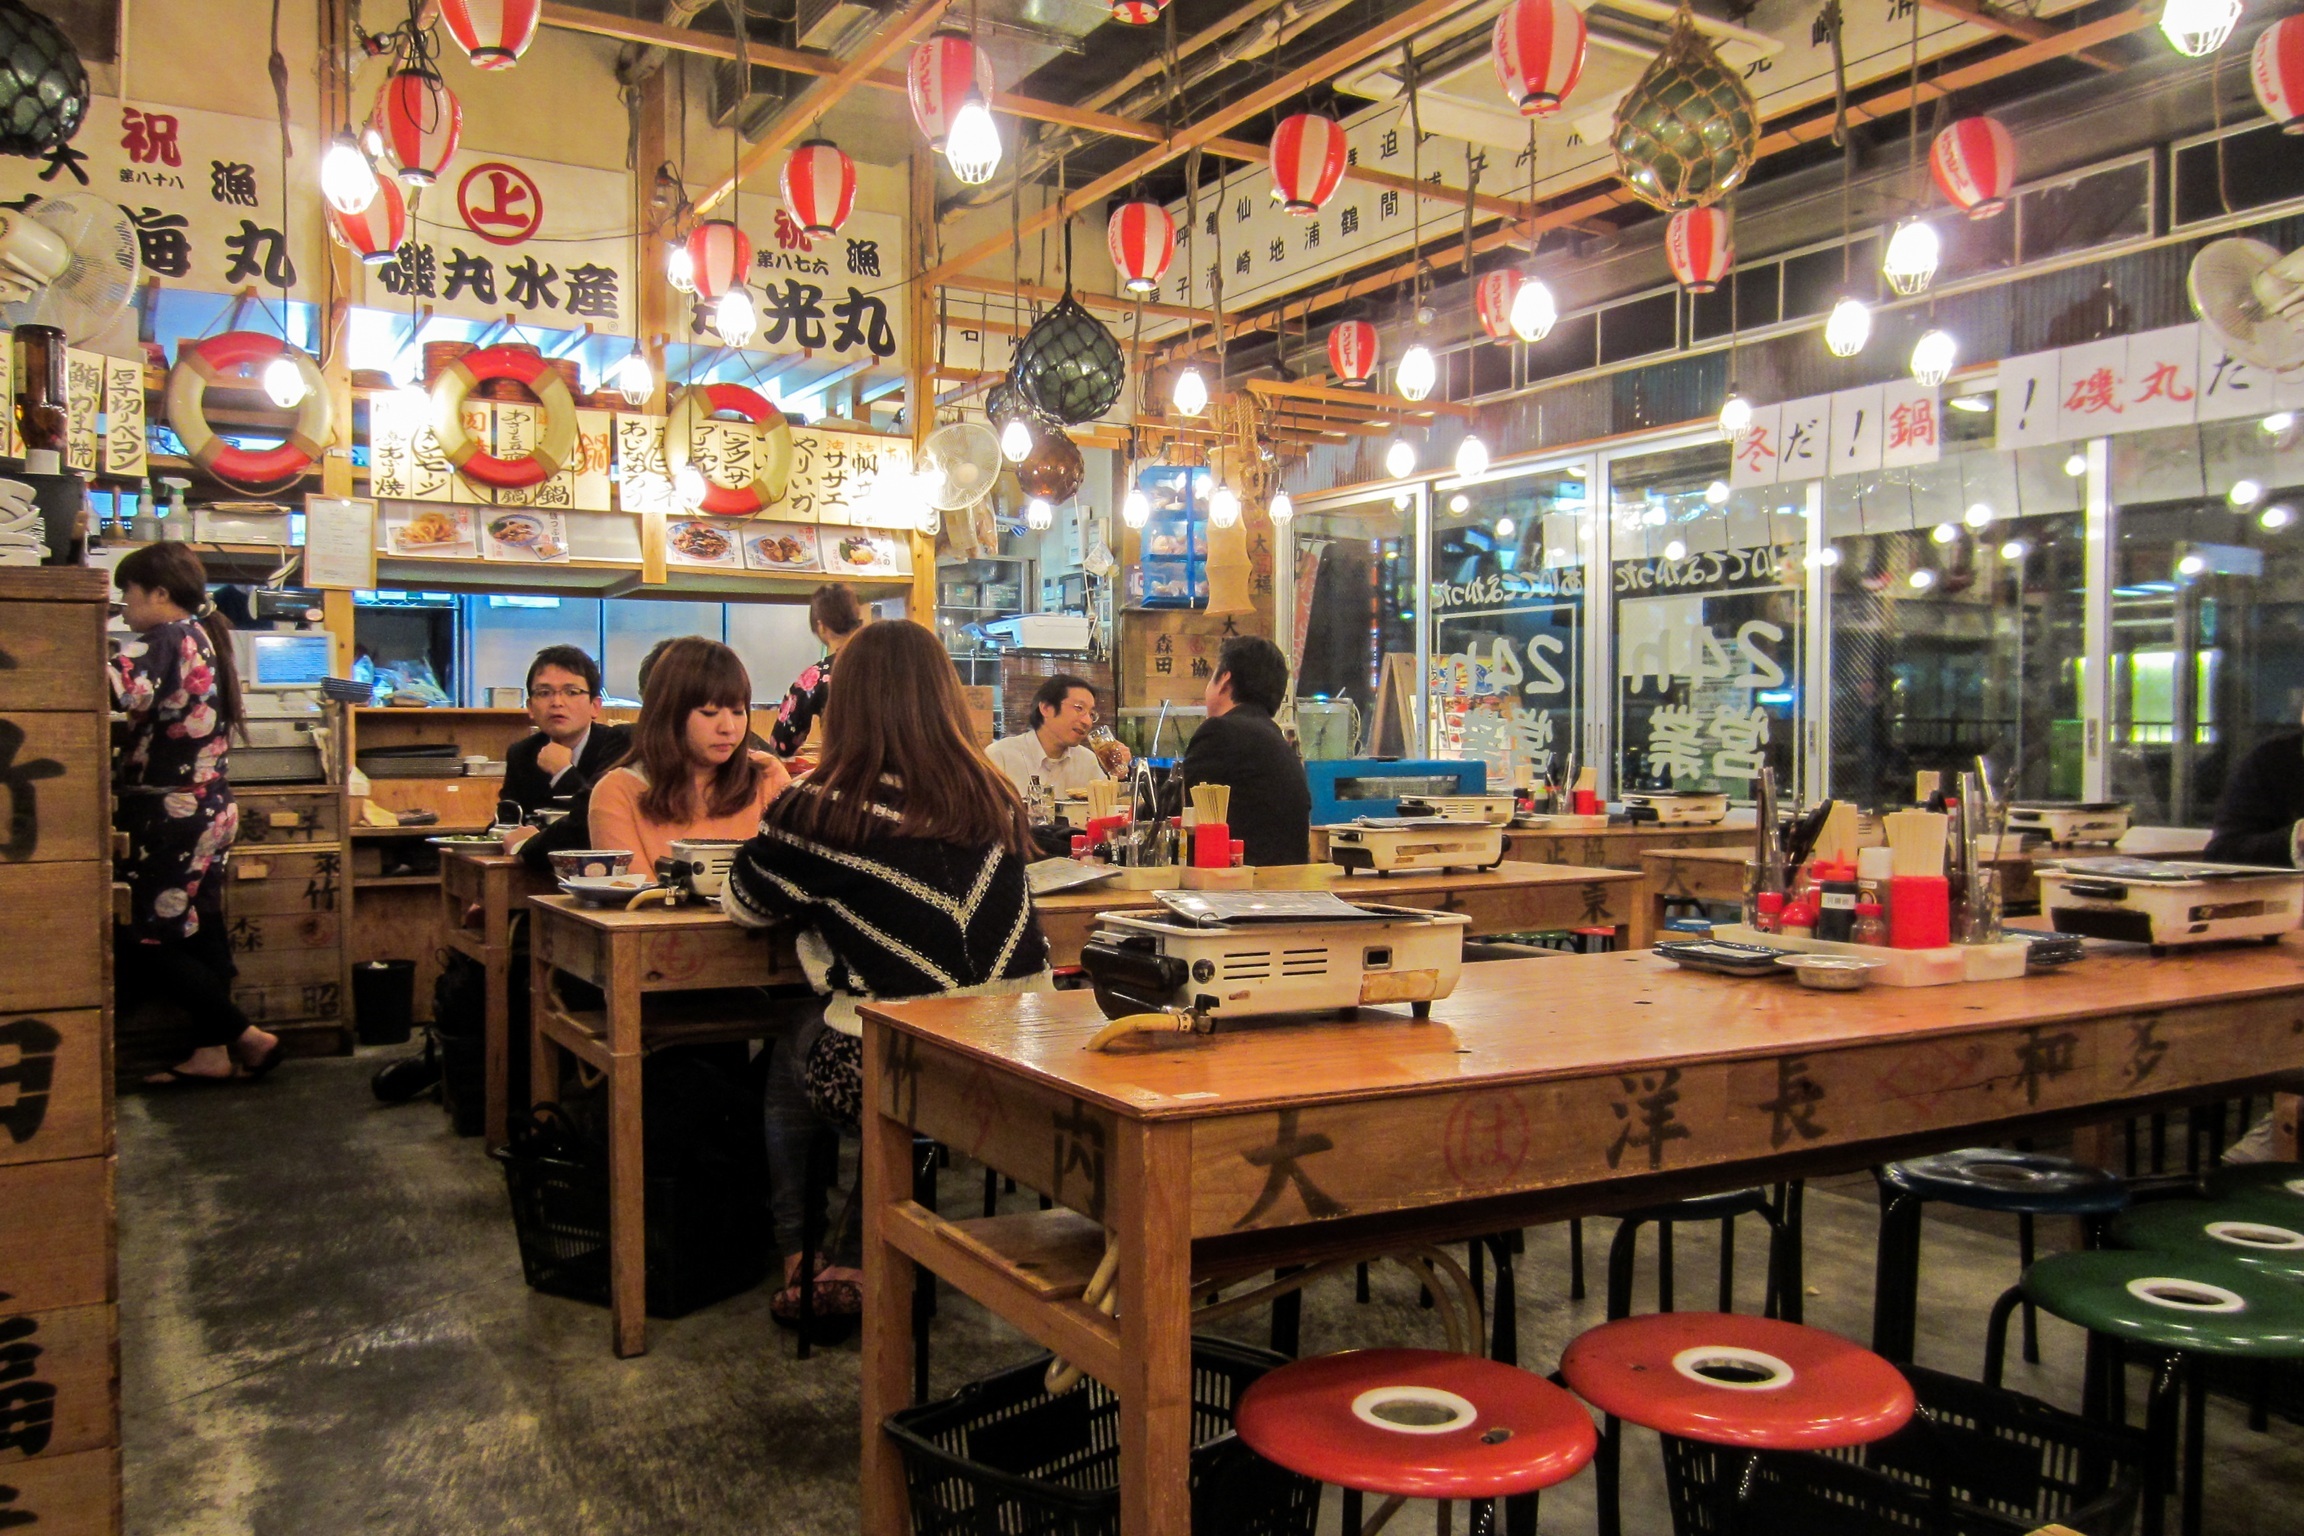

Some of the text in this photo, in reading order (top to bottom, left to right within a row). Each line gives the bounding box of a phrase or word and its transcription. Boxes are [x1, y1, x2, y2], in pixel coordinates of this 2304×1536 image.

[120, 106, 182, 168] 祝
[119, 168, 185, 190] 第八十八
[210, 159, 259, 208] 漁
[470, 170, 532, 228] 上
[756, 249, 830, 276] 第八七六
[846, 238, 881, 278] 漁
[1236, 195, 1252, 276] 仙崎
[377, 240, 620, 320] 磯丸水産
[619, 420, 648, 508] あじなめろう
[790, 435, 819, 514] やりいか
[1233, 1108, 1350, 1229] 大
[1606, 1069, 1693, 1170] 洋
